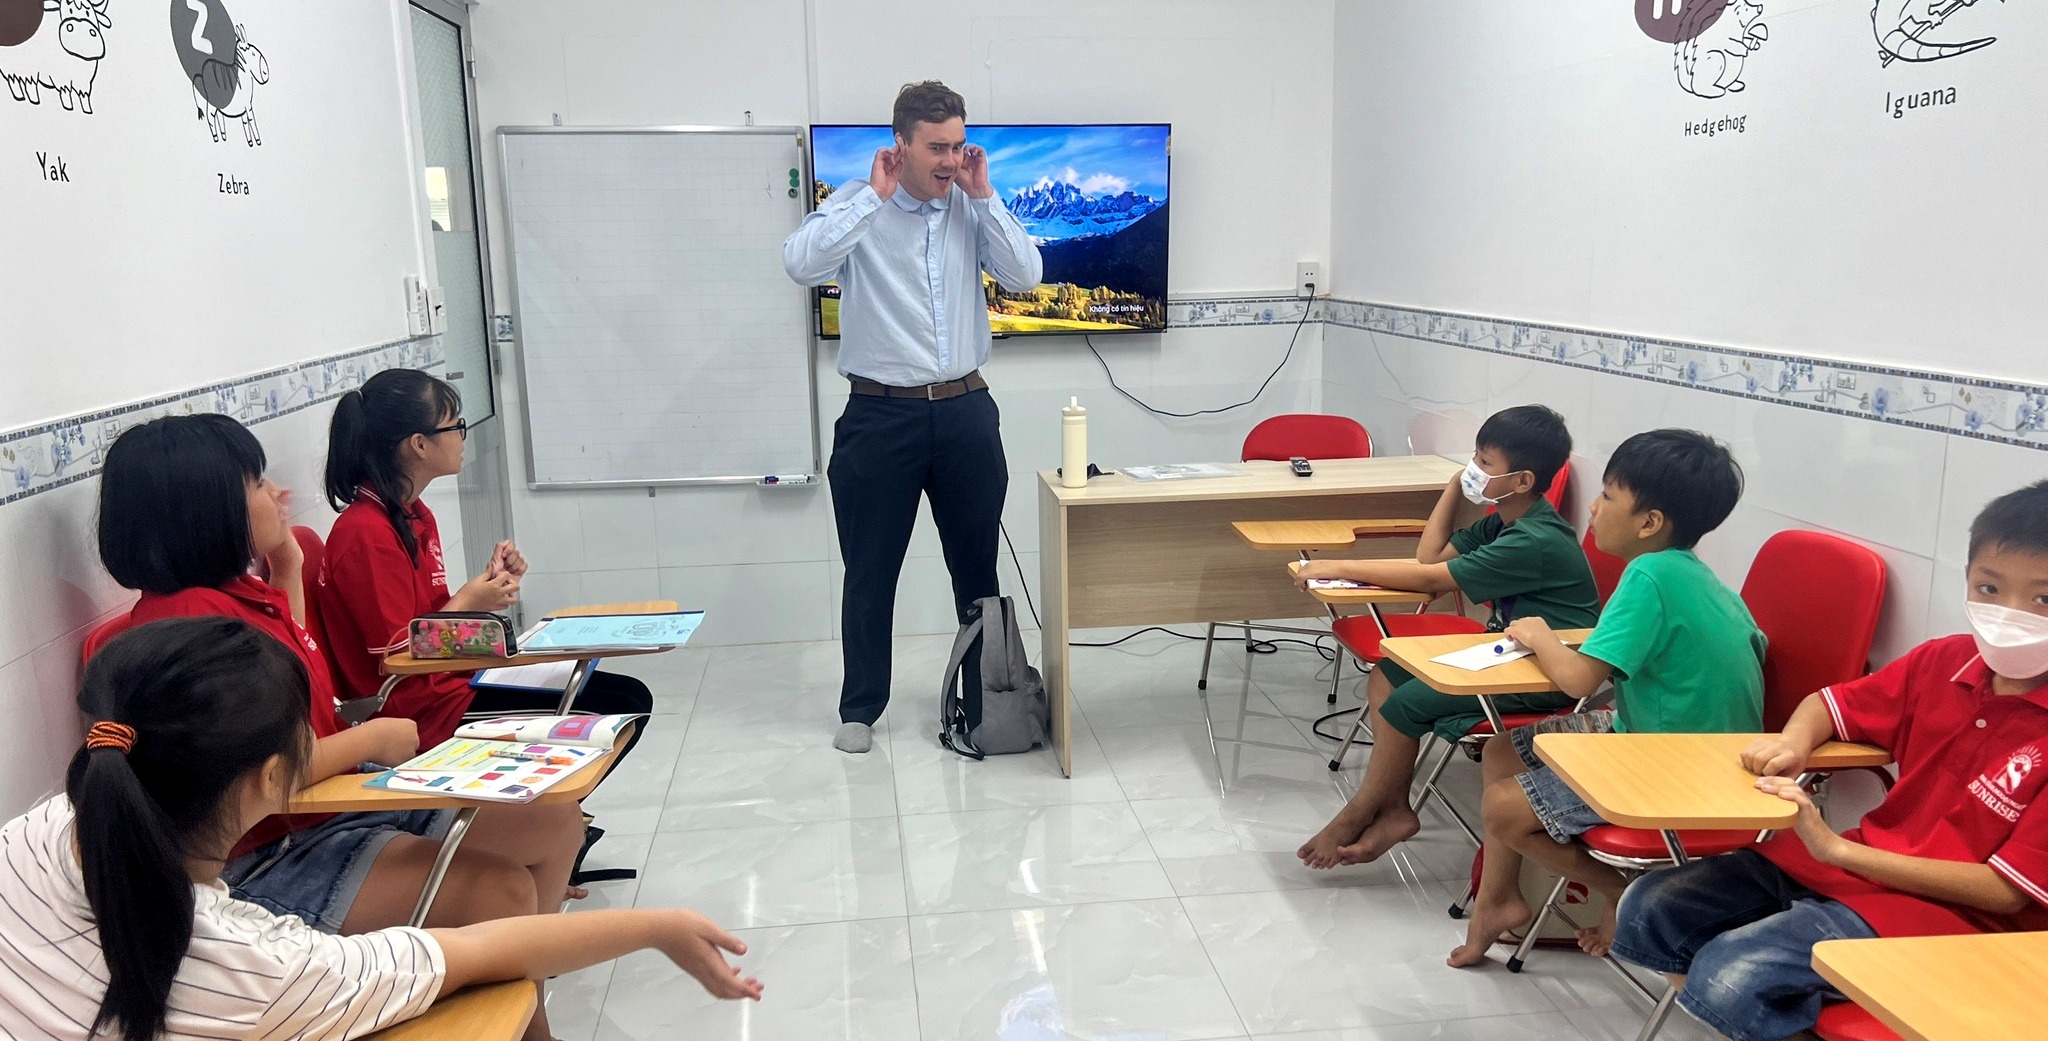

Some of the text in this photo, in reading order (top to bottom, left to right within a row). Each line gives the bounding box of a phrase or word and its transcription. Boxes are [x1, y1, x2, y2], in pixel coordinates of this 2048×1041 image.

[1886, 86, 1957, 119] Iguana
[1684, 114, 1747, 137] Hedgehog
[35, 151, 70, 183] Yak
[217, 172, 250, 196] Zebra
[1120, 304, 1130, 312] tin
[1967, 779, 2021, 823] SUNRISE
